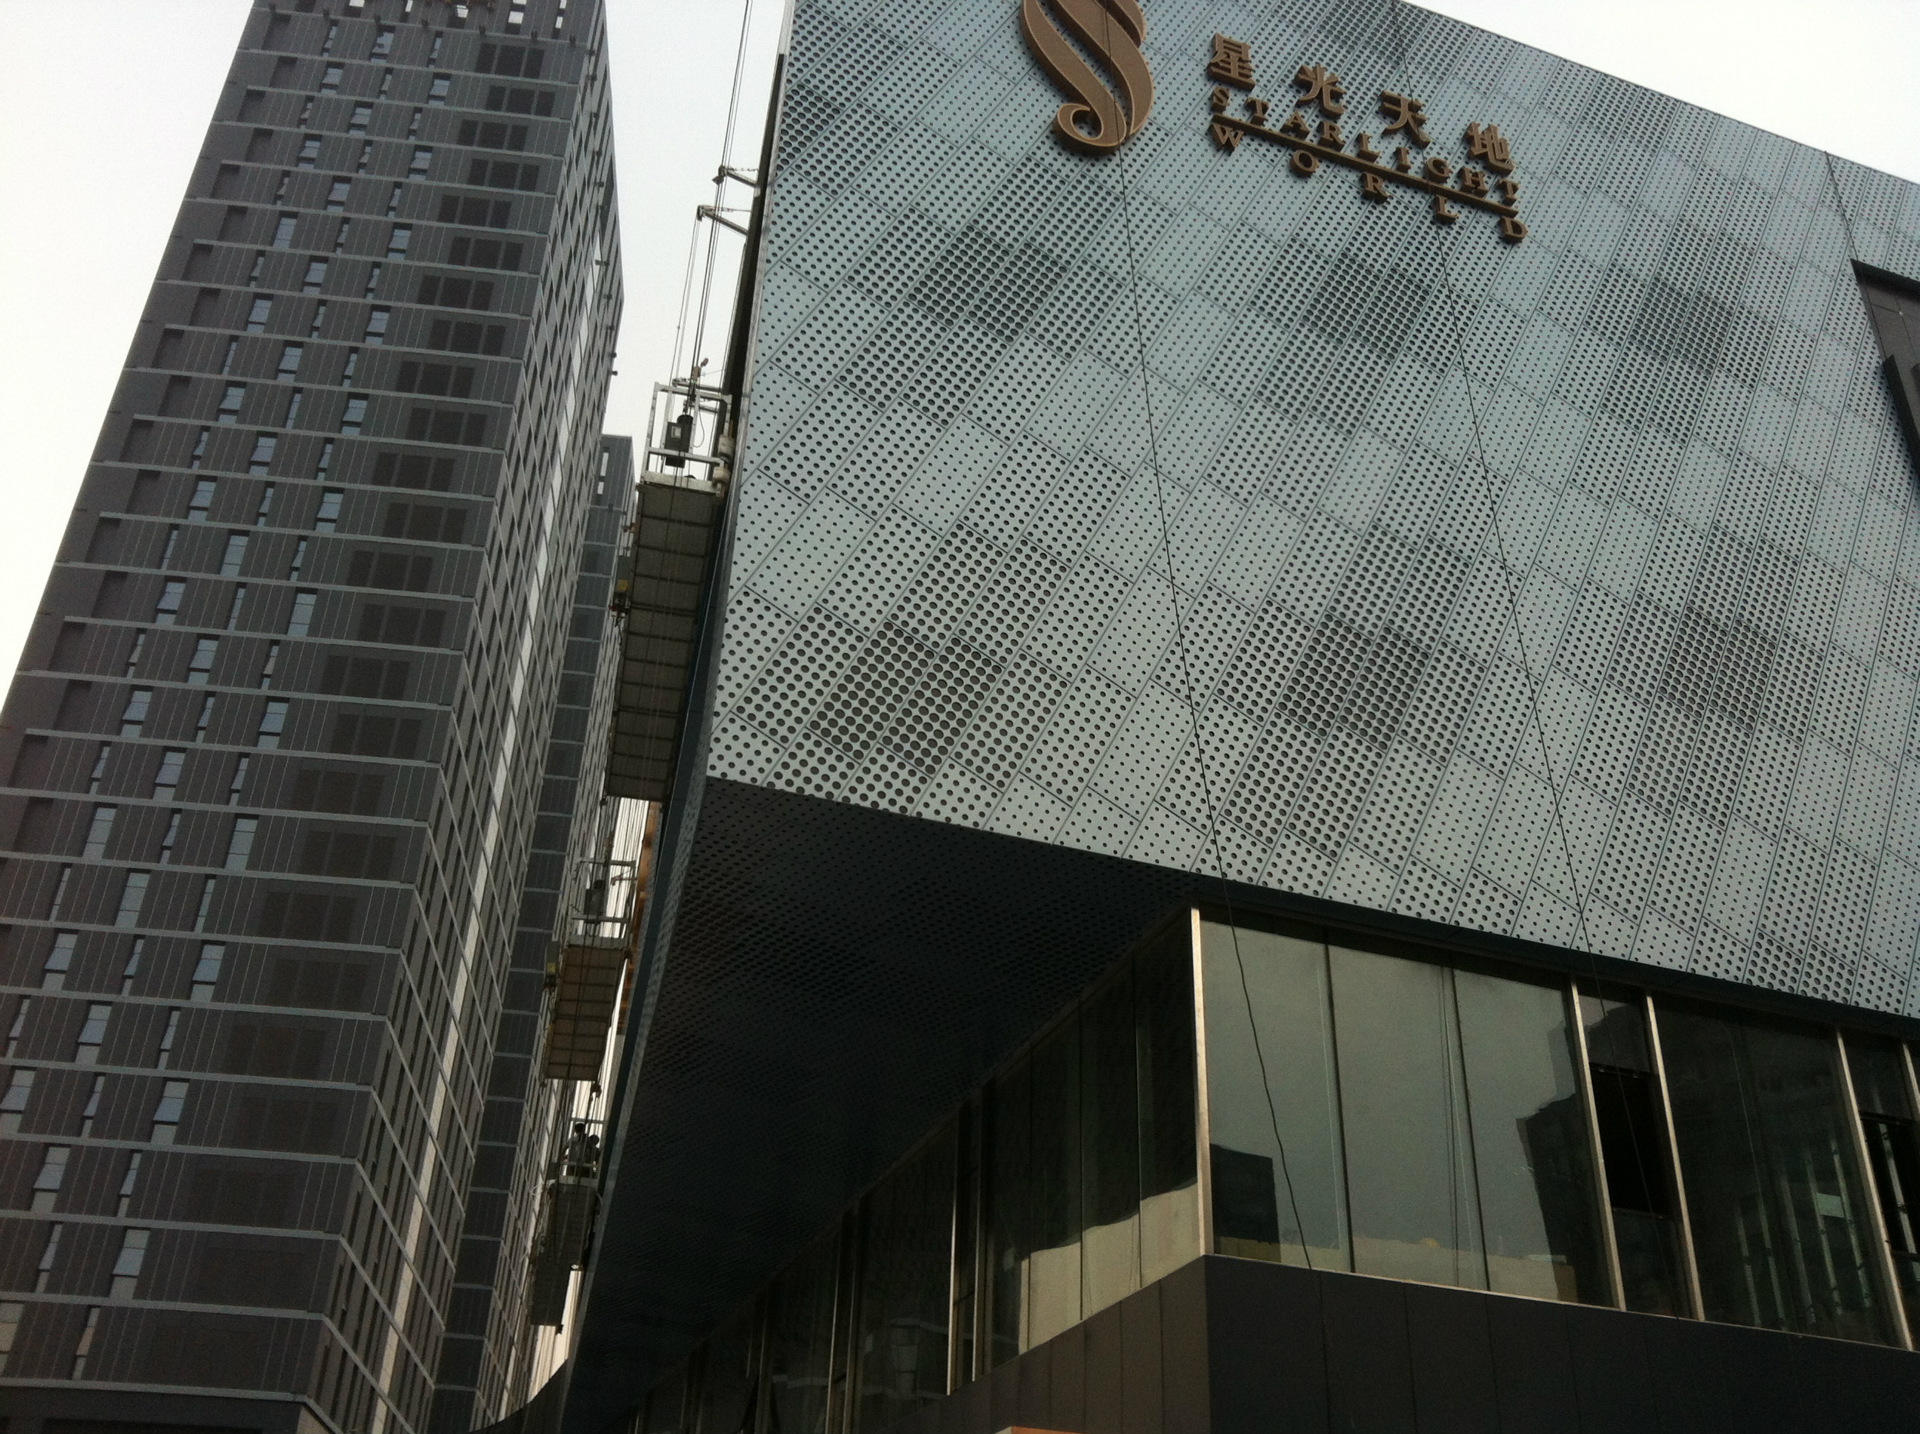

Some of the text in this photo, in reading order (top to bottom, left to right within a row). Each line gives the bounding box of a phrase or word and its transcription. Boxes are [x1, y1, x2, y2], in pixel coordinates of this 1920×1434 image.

[1207, 32, 1514, 175] 星光天地
[1211, 86, 1519, 205] STARLIGHT
[1209, 123, 1528, 243] WORLD
